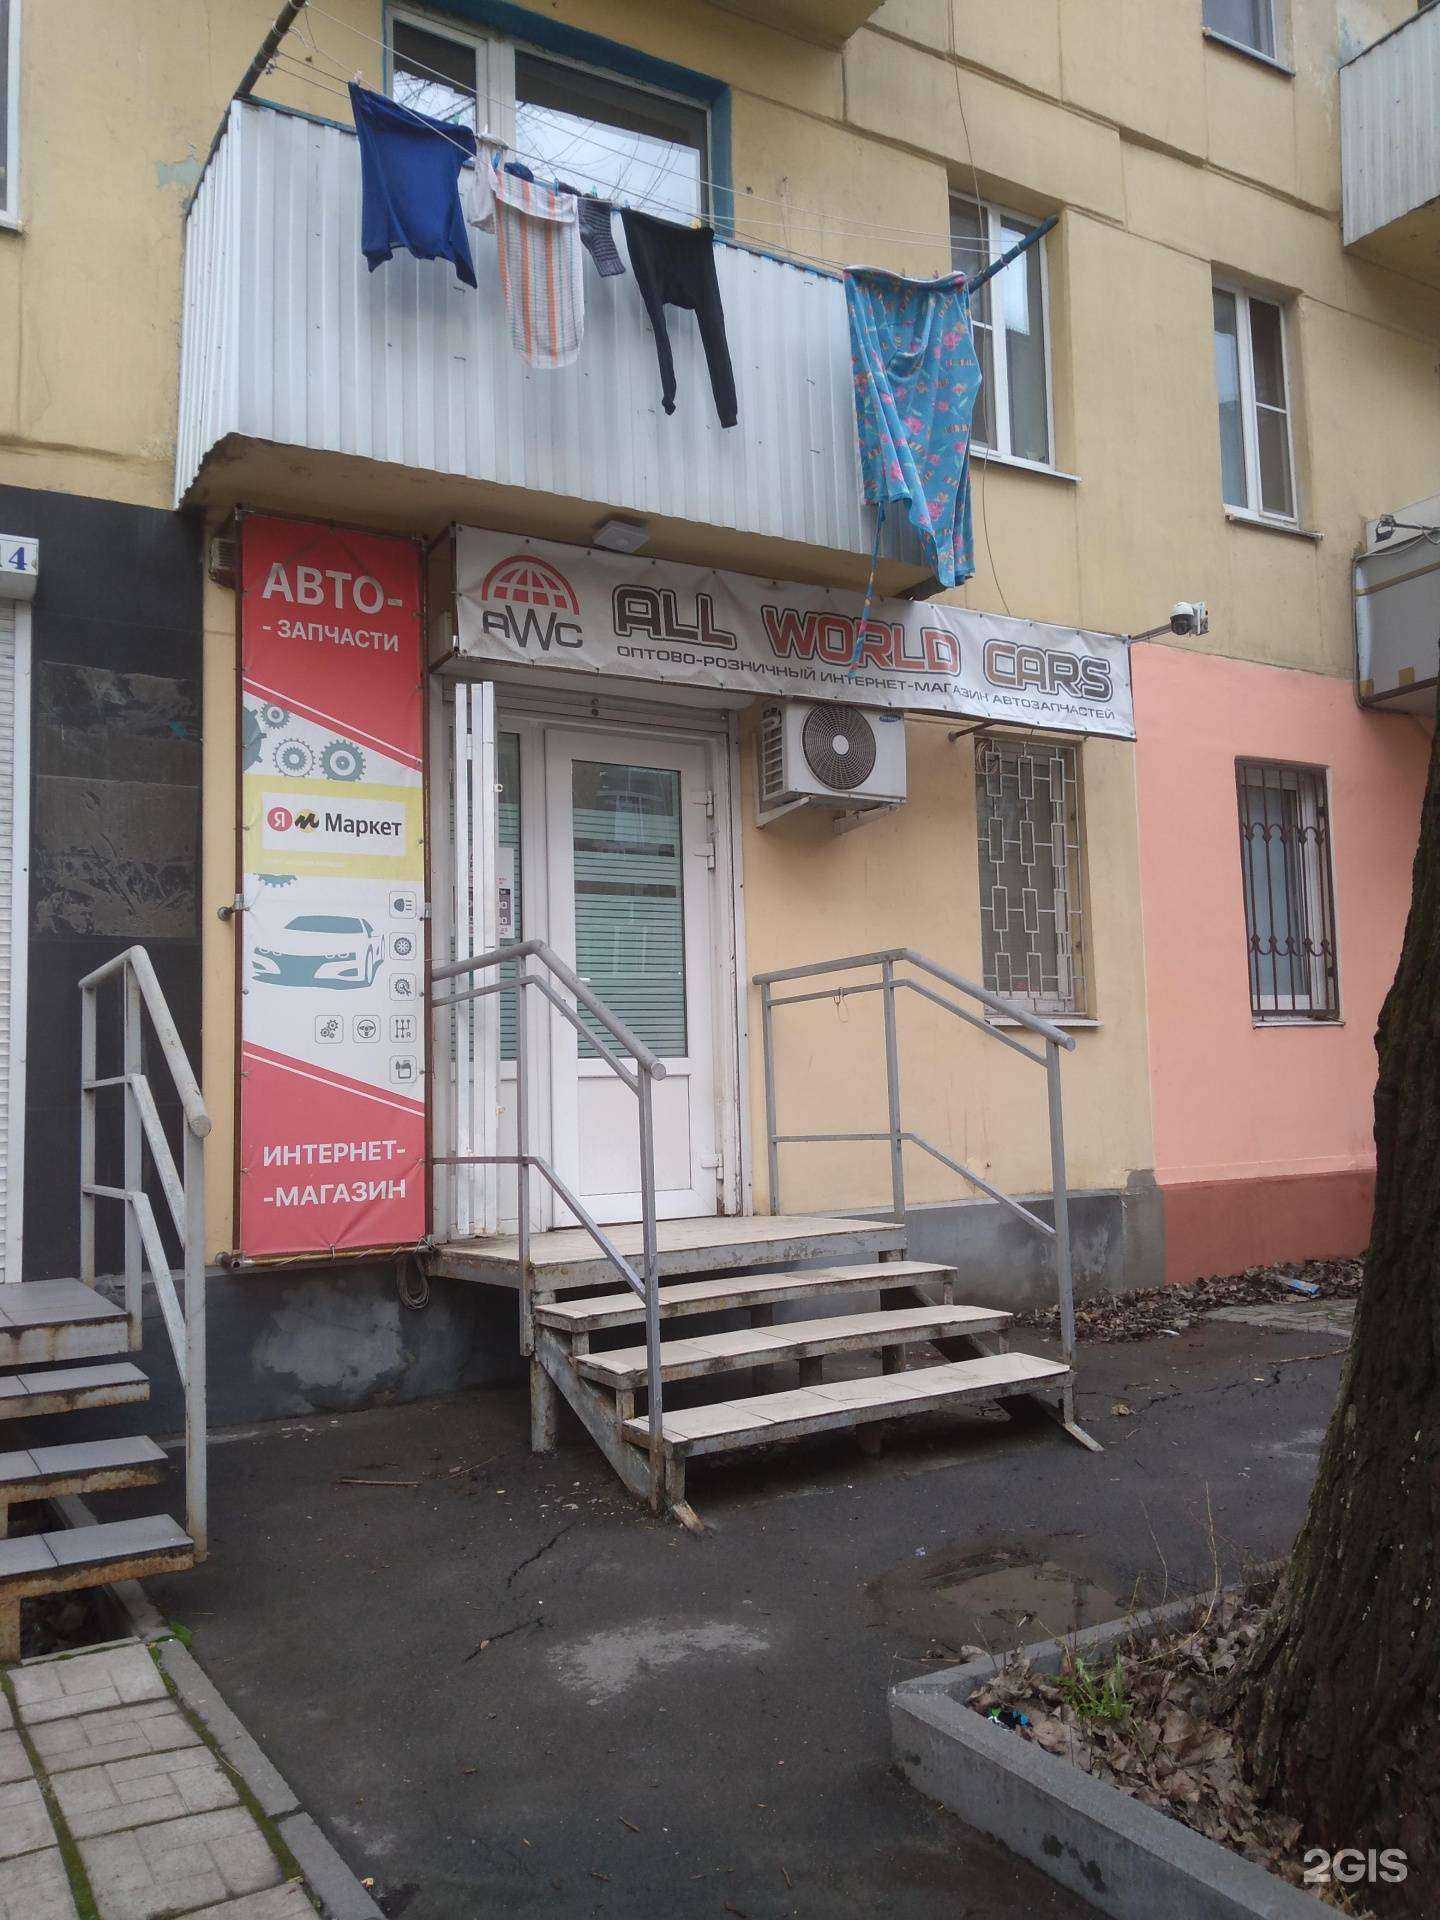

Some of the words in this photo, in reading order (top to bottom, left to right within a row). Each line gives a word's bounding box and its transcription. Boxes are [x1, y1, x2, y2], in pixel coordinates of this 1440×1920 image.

[0, 545, 27, 570] 4
[261, 562, 403, 615] АВТО-
[482, 604, 583, 651] AWC
[612, 583, 738, 650] ALL
[760, 605, 962, 677] WORLD
[983, 638, 1115, 702] CARS
[616, 645, 816, 682] ОПТОВО-РОЗНИЧНЫЙ
[820, 671, 989, 704] ИНТЕРНЕТ-МАГАЗИН
[992, 692, 1115, 720] АВТОЗАПЧАСТЕЙ
[325, 812, 402, 837] Маркет
[262, 1138, 406, 1167] ИНТЕРНЕТ-
[263, 1178, 407, 1208] -МАГАЗИН
